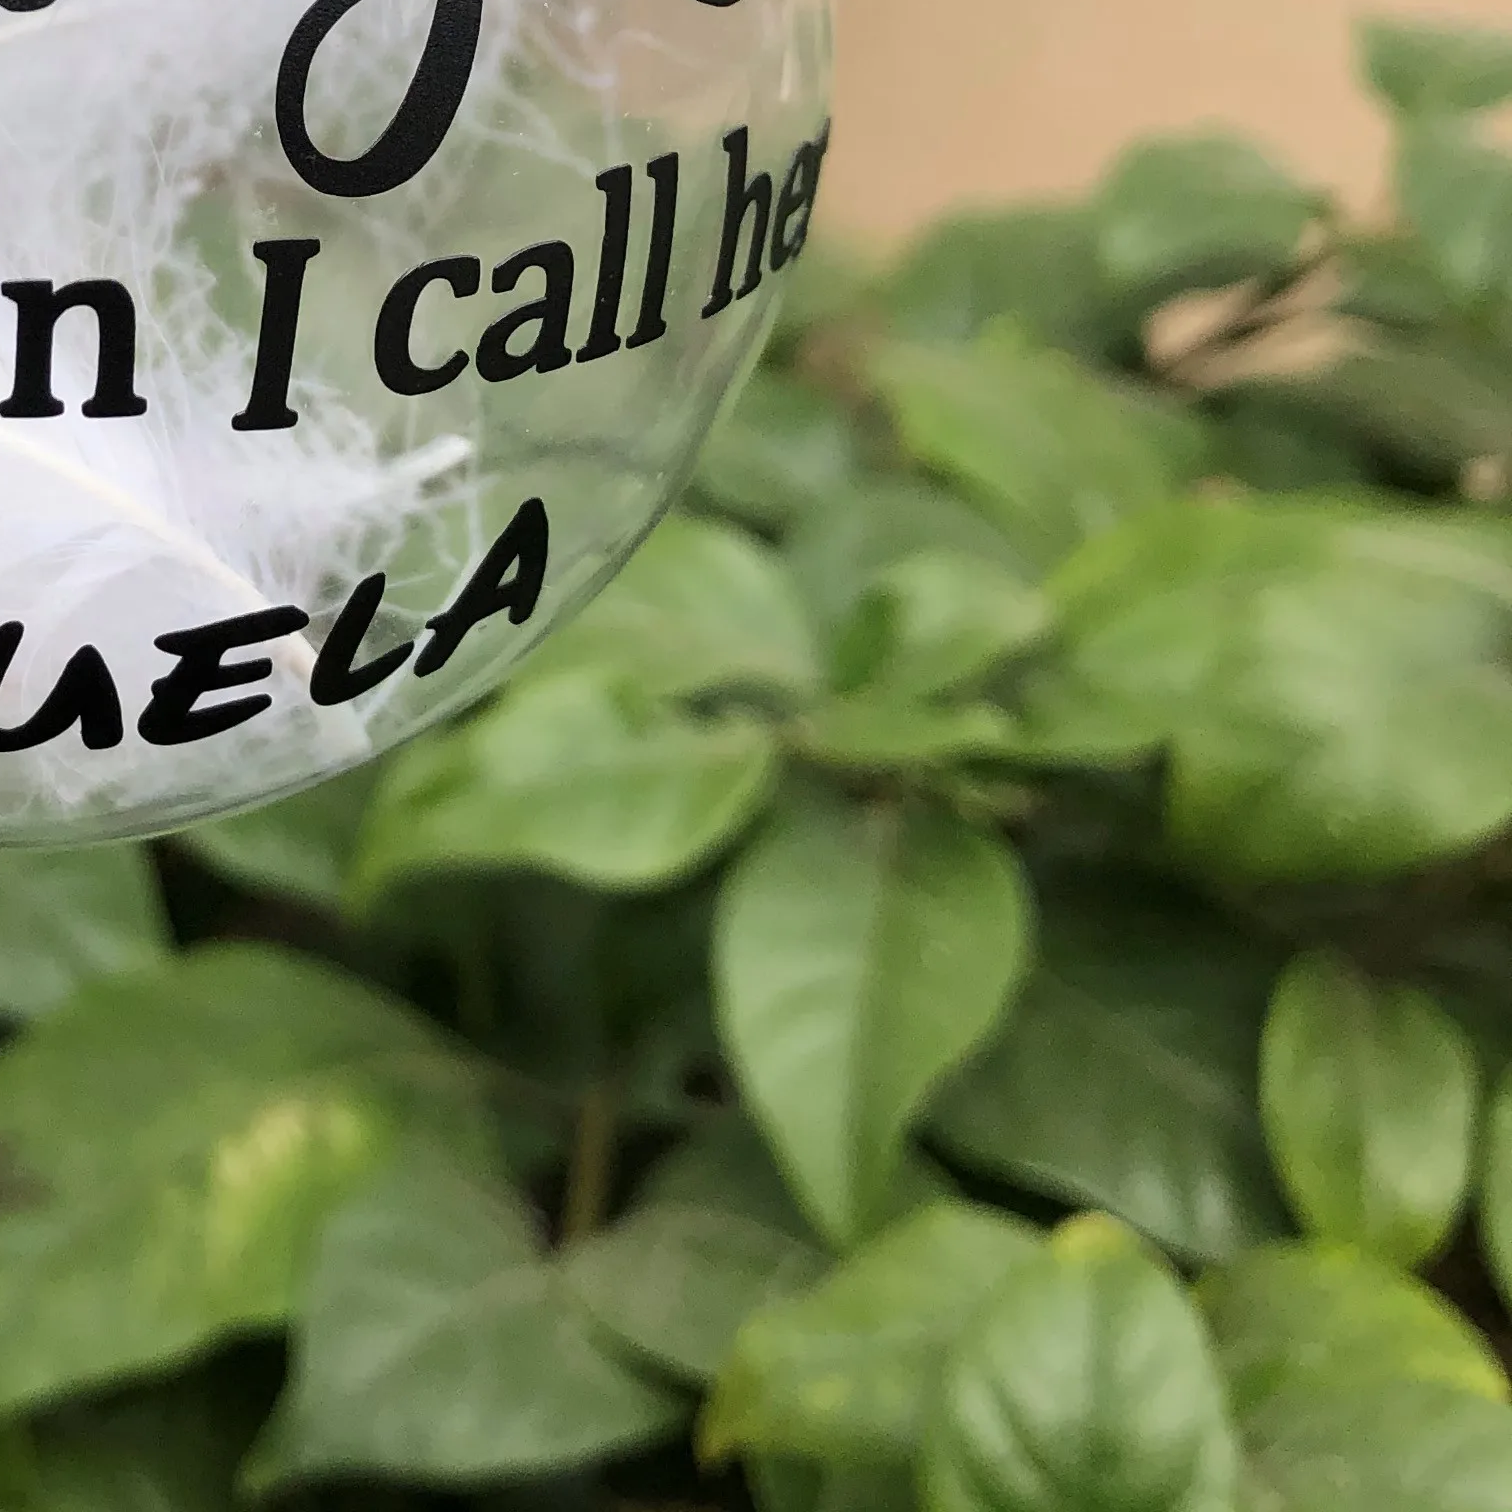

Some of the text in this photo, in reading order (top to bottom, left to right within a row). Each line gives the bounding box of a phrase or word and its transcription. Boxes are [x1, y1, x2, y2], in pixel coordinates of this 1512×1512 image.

[231, 238, 321, 432] I
[374, 151, 679, 397] call
[700, 117, 831, 320] he
